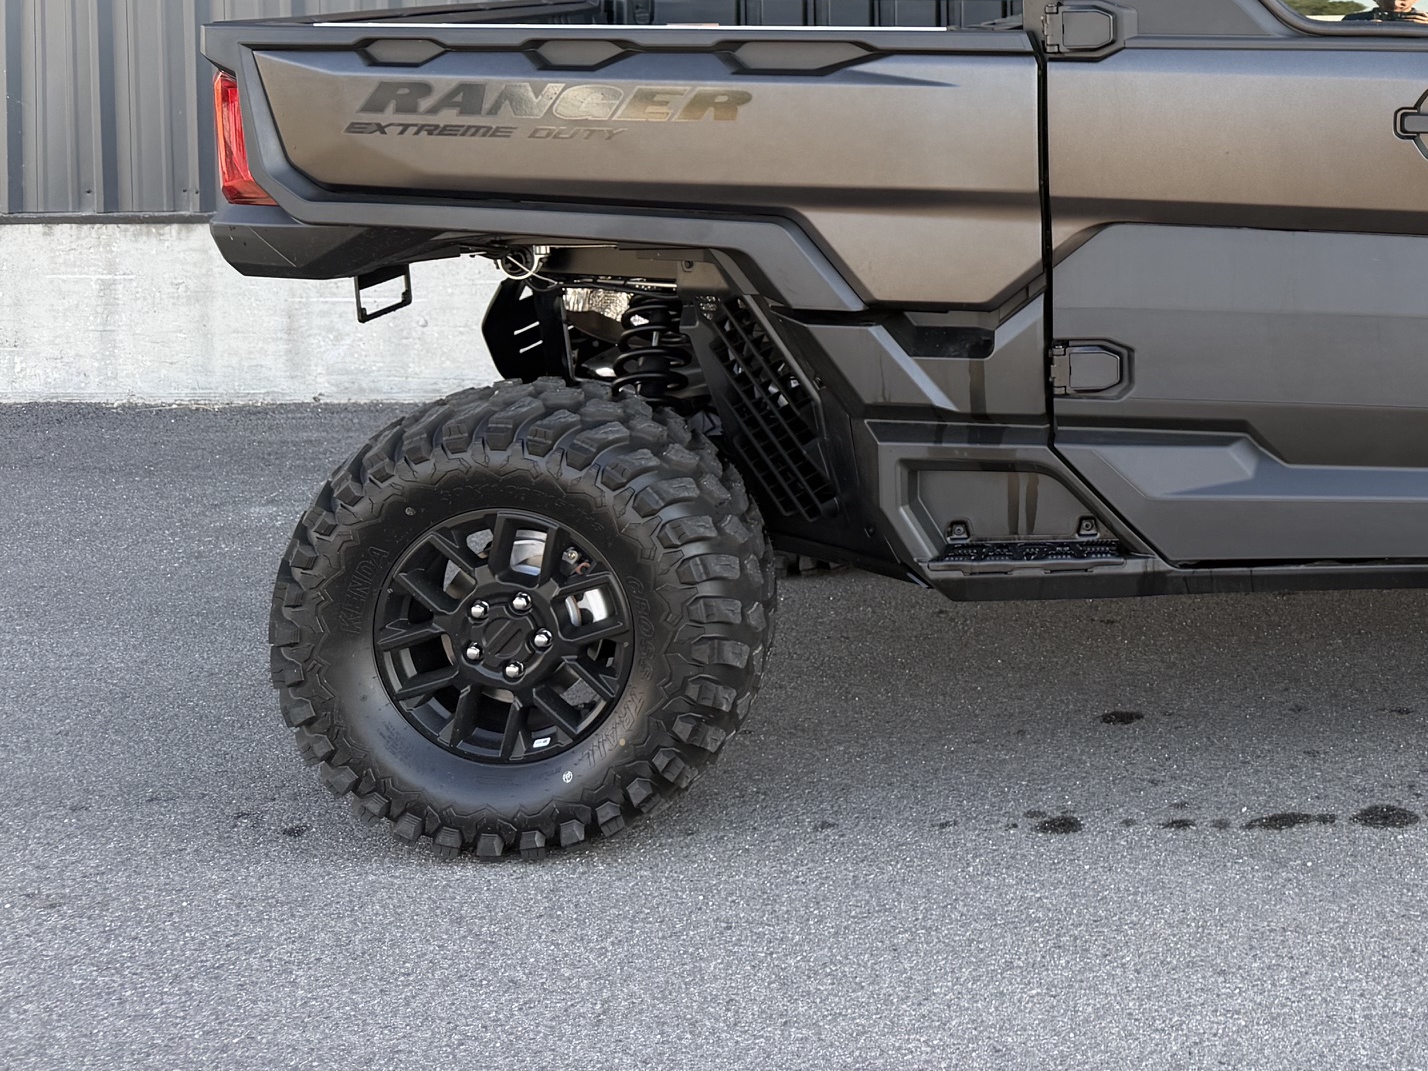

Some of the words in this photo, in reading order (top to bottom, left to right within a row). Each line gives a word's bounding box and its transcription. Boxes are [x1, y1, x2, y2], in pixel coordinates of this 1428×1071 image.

[356, 81, 753, 121] RANGER
[342, 122, 517, 138] EXTREME
[528, 126, 628, 141] DUTY
[337, 545, 390, 634] KENDA
[571, 686, 646, 767] TRAIL
